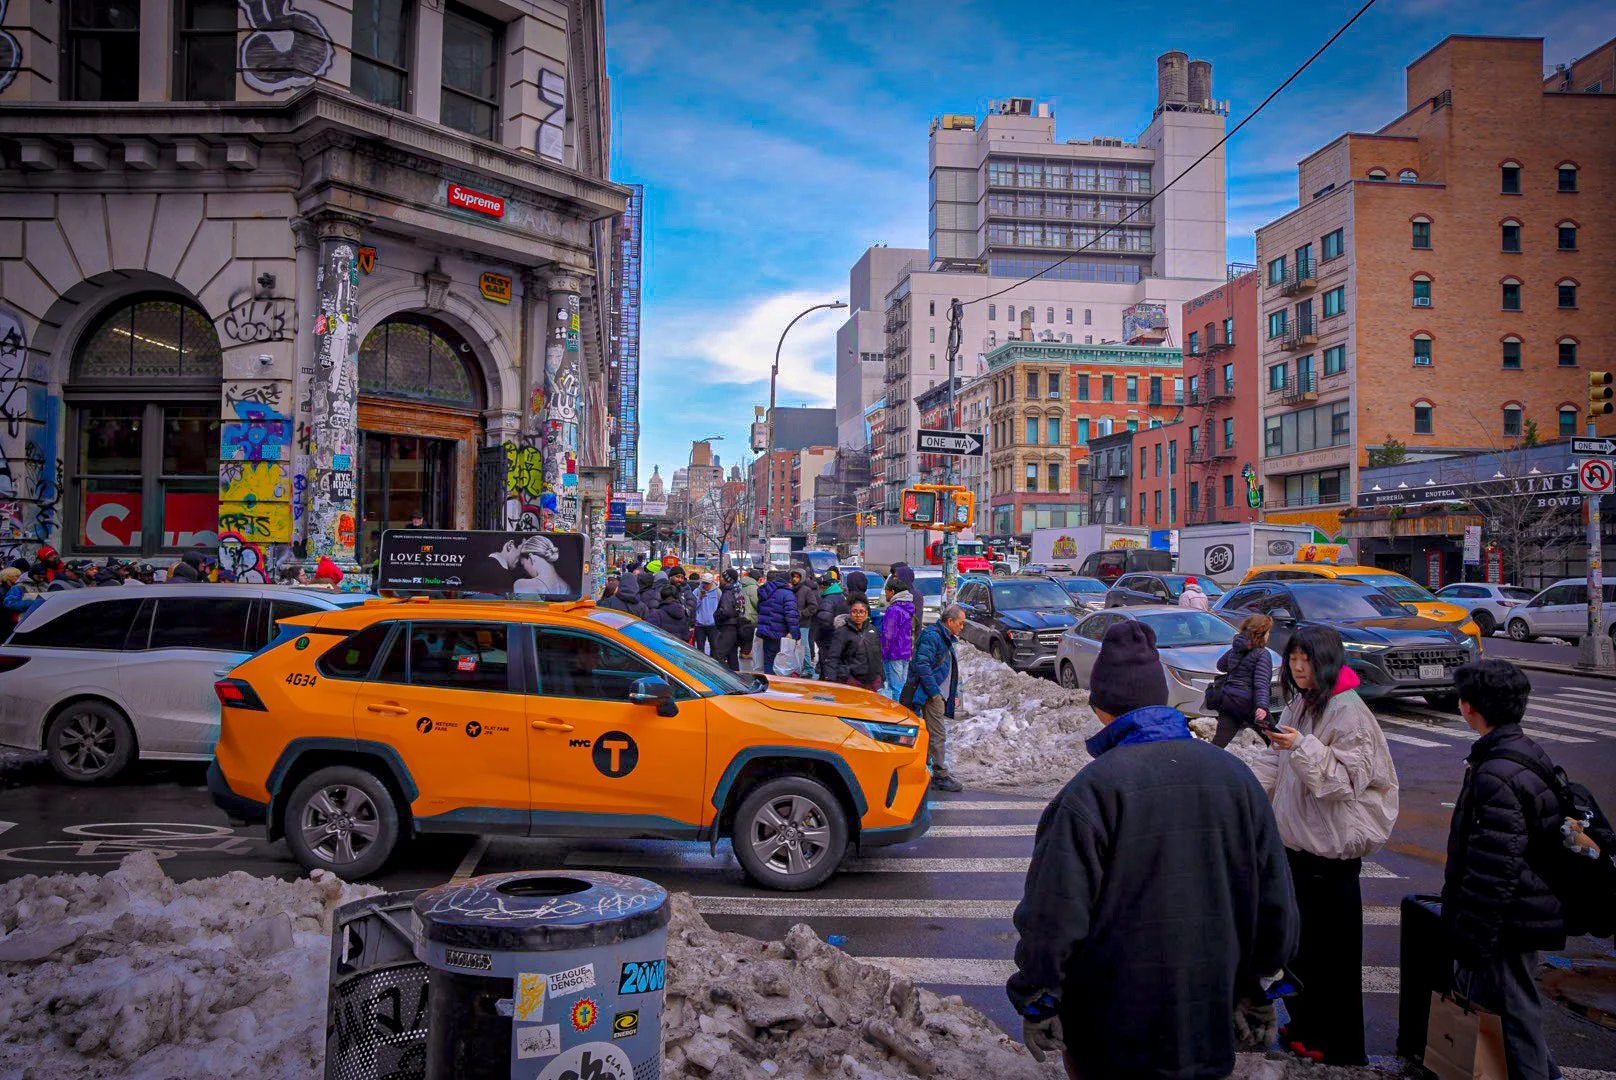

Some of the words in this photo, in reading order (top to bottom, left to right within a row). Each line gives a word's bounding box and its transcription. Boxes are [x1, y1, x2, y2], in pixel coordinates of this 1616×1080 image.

[453, 187, 501, 212] Supreme
[926, 437, 946, 448] ONE
[954, 439, 974, 449] WAY
[1578, 442, 1593, 450] ONE
[1598, 443, 1613, 451] WAY
[334, 472, 351, 481] NYC
[333, 480, 352, 489] KUSH
[337, 488, 350, 497] CO.
[1425, 489, 1455, 498] ENOTECA
[390, 553, 421, 562] LOVE
[425, 554, 466, 563] STORY
[1209, 551, 1228, 565] edge
[285, 672, 317, 688] 4G34
[569, 739, 591, 748] NYC
[602, 740, 629, 772] T
[550, 966, 586, 983] TEAGUE
[550, 976, 584, 992] DENSO
[613, 1028, 637, 1039] ENERGY
[605, 1054, 627, 1077] CLAY
